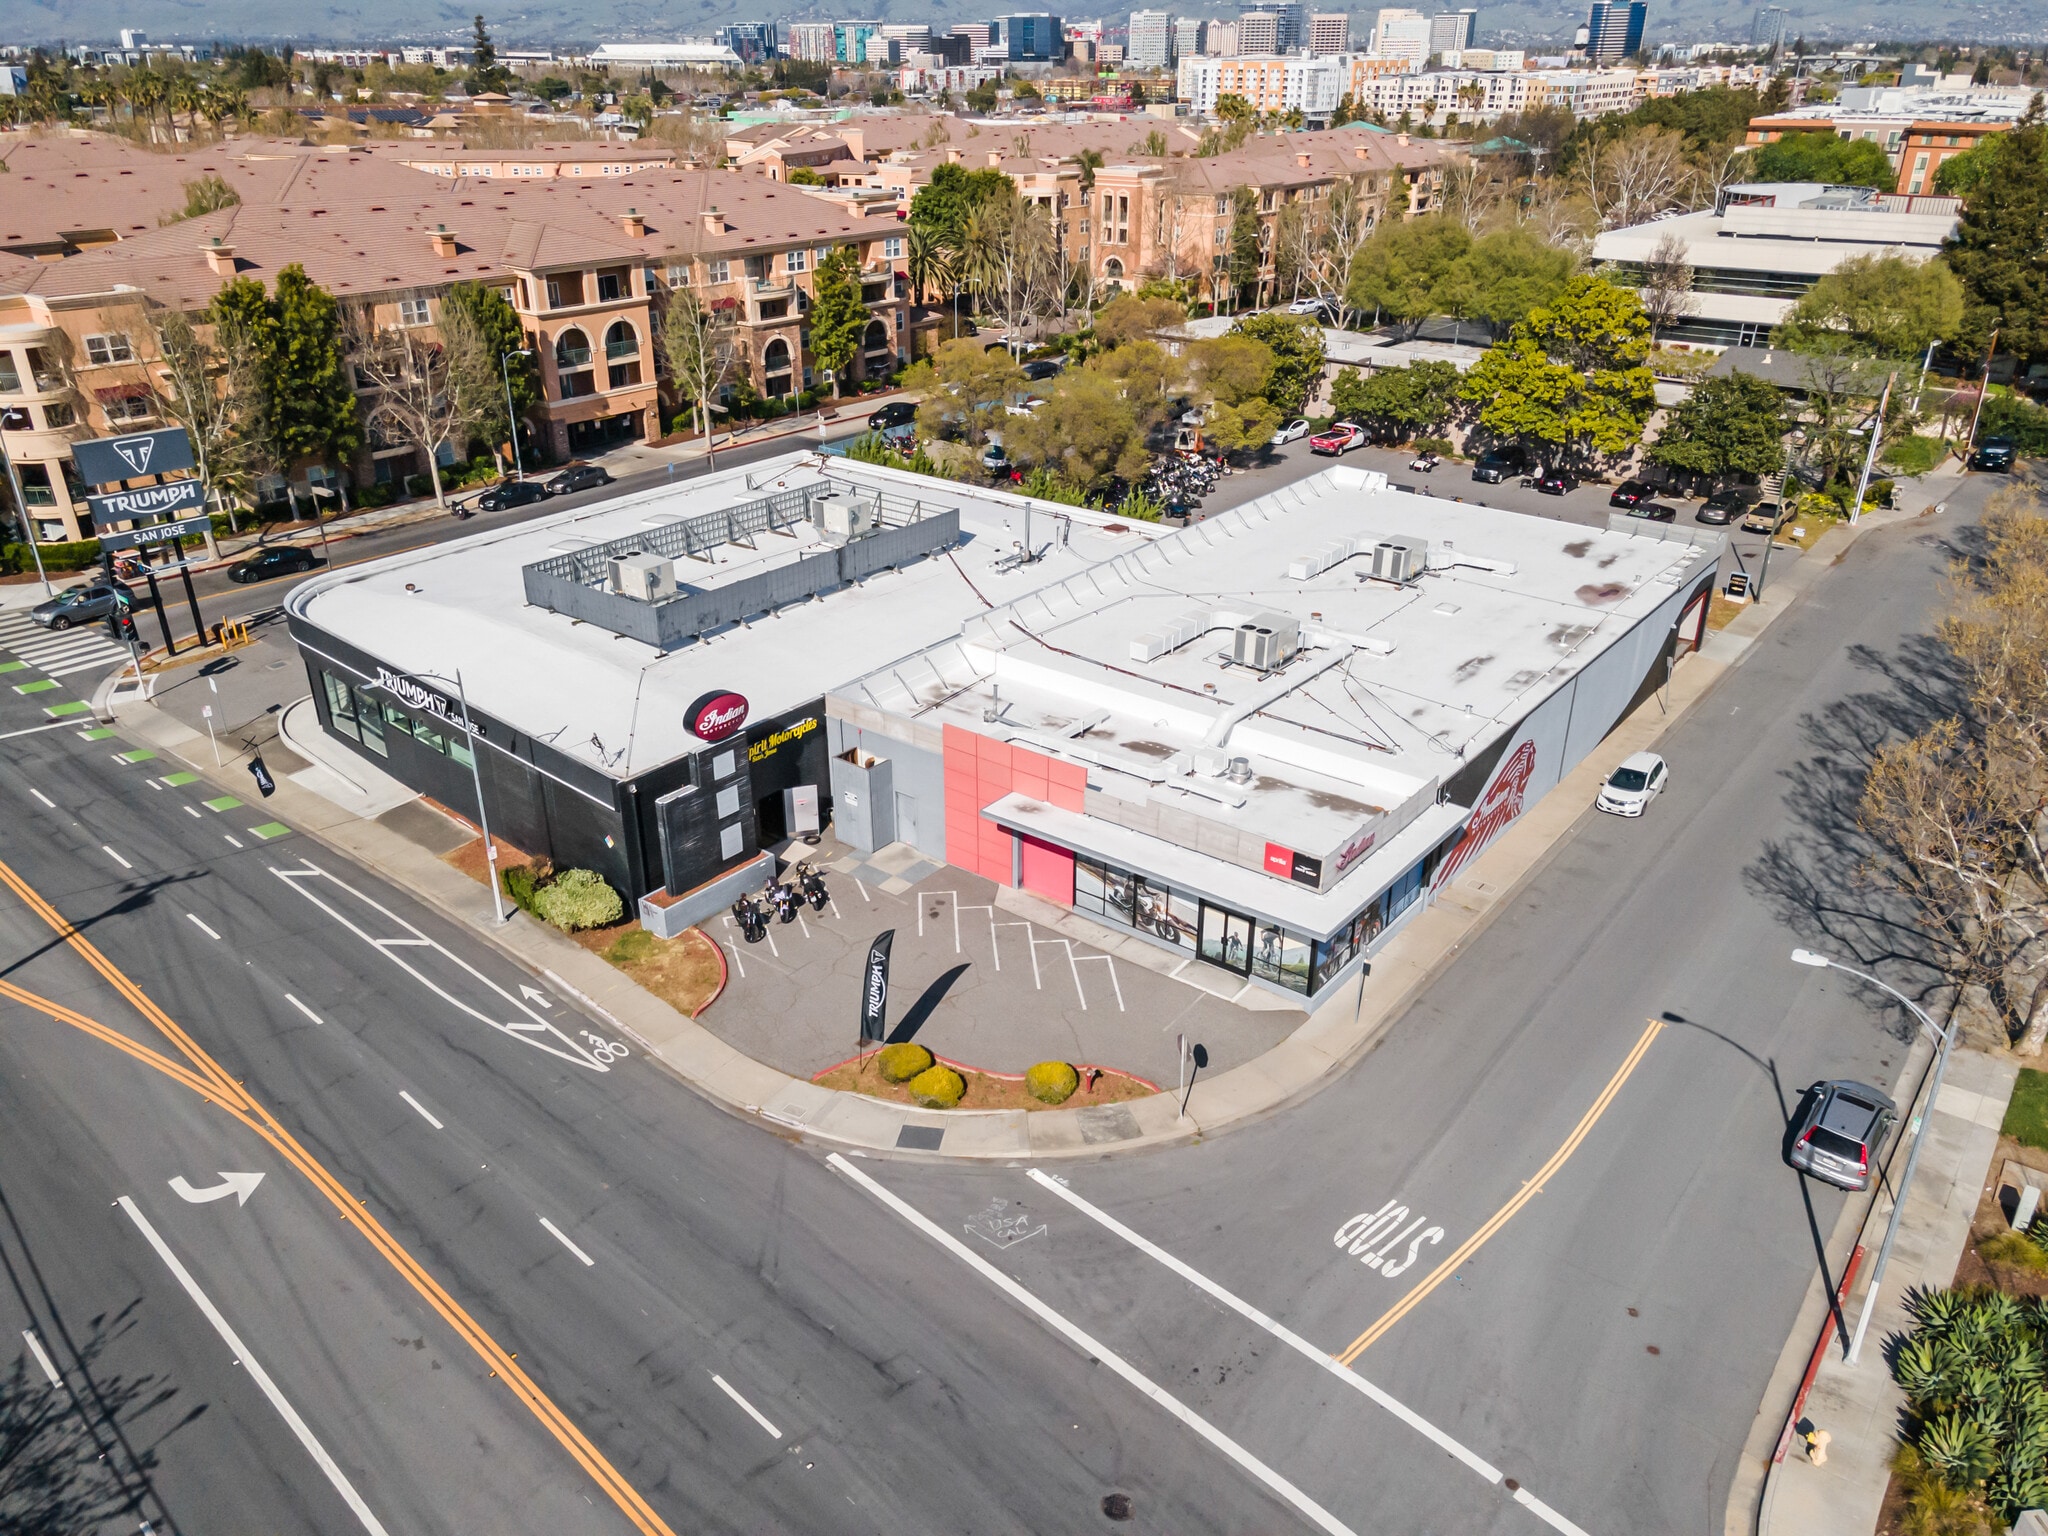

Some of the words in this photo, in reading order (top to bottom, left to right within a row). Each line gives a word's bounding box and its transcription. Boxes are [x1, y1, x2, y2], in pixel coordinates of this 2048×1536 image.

[102, 484, 196, 514] TRIUMPH
[133, 530, 158, 544] SAN
[160, 524, 187, 540] JOSE
[376, 666, 435, 709] TRIUMPH
[451, 712, 465, 727] SAN
[699, 704, 745, 731] Indian
[768, 719, 818, 748] Motorcycles
[868, 965, 886, 1018] TRIUMPH
[1333, 1199, 1445, 1278] STOP
